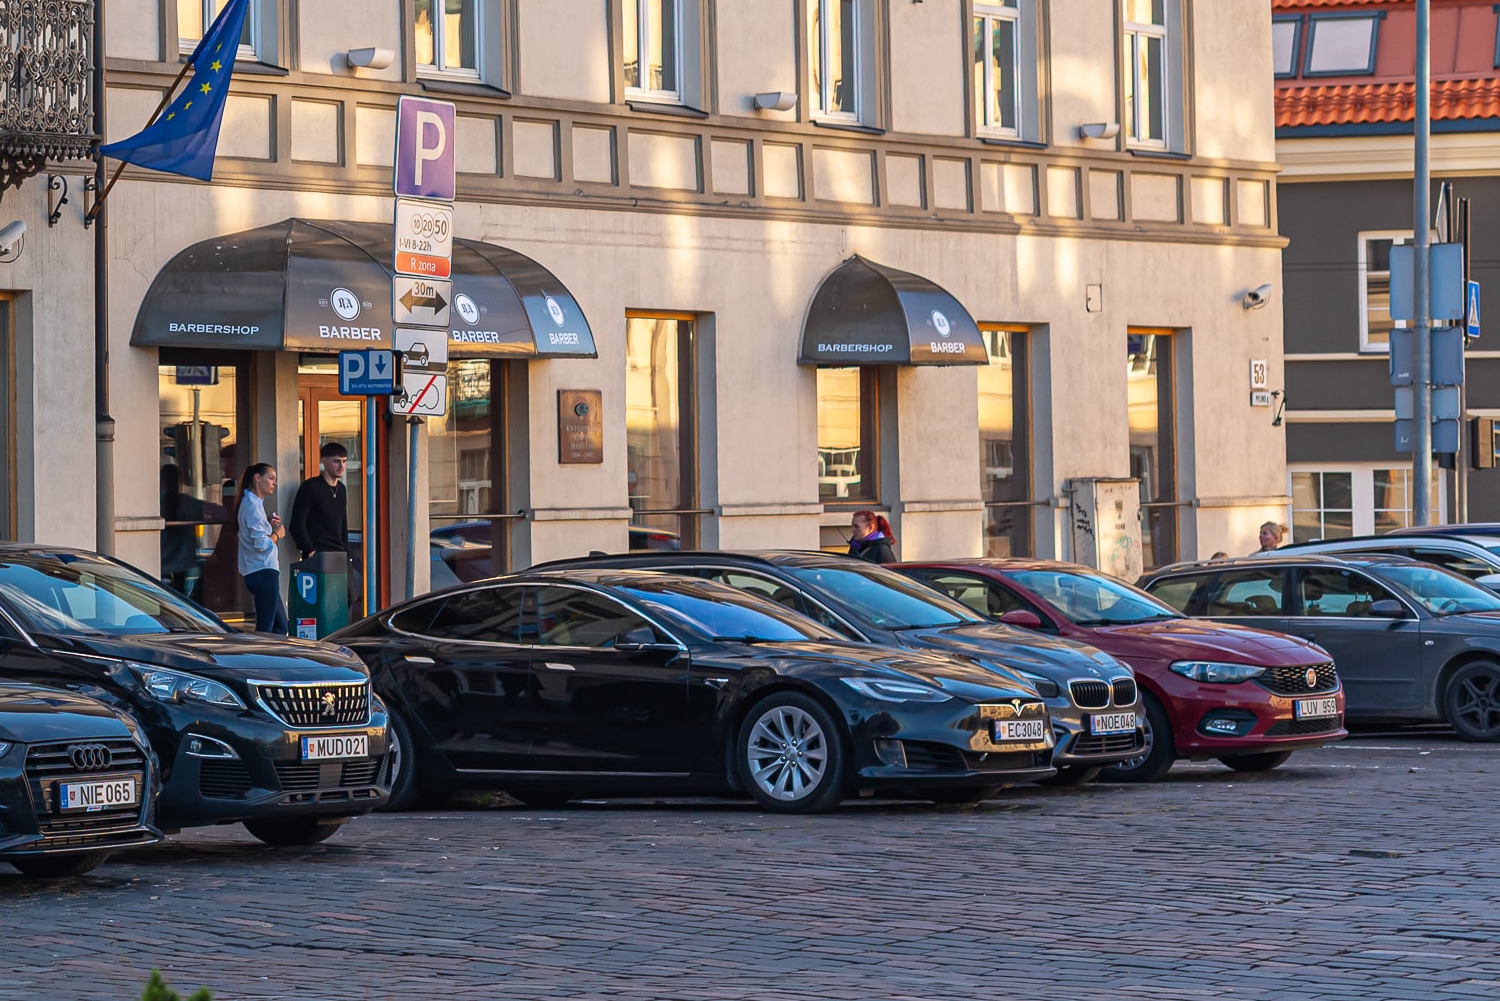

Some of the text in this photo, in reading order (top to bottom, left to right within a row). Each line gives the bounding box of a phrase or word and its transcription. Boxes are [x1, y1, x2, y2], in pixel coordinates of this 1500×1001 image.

[414, 110, 447, 187] P
[413, 219, 448, 236] 10 20 50
[399, 237, 432, 253] I-VI 8-22h
[410, 257, 437, 273] R zona
[414, 281, 434, 297] 30m
[169, 323, 260, 335] BARBERSHOP
[319, 325, 382, 341] BARBER
[452, 330, 500, 343] BARBER
[549, 332, 579, 345] BARBER
[818, 343, 893, 353] BARBERSHOP
[930, 341, 966, 354] BARBER
[343, 353, 365, 392] P
[1253, 363, 1265, 384] 53
[302, 575, 314, 599] P
[1301, 700, 1335, 715] LUV 959
[1008, 721, 1043, 738] EC3048
